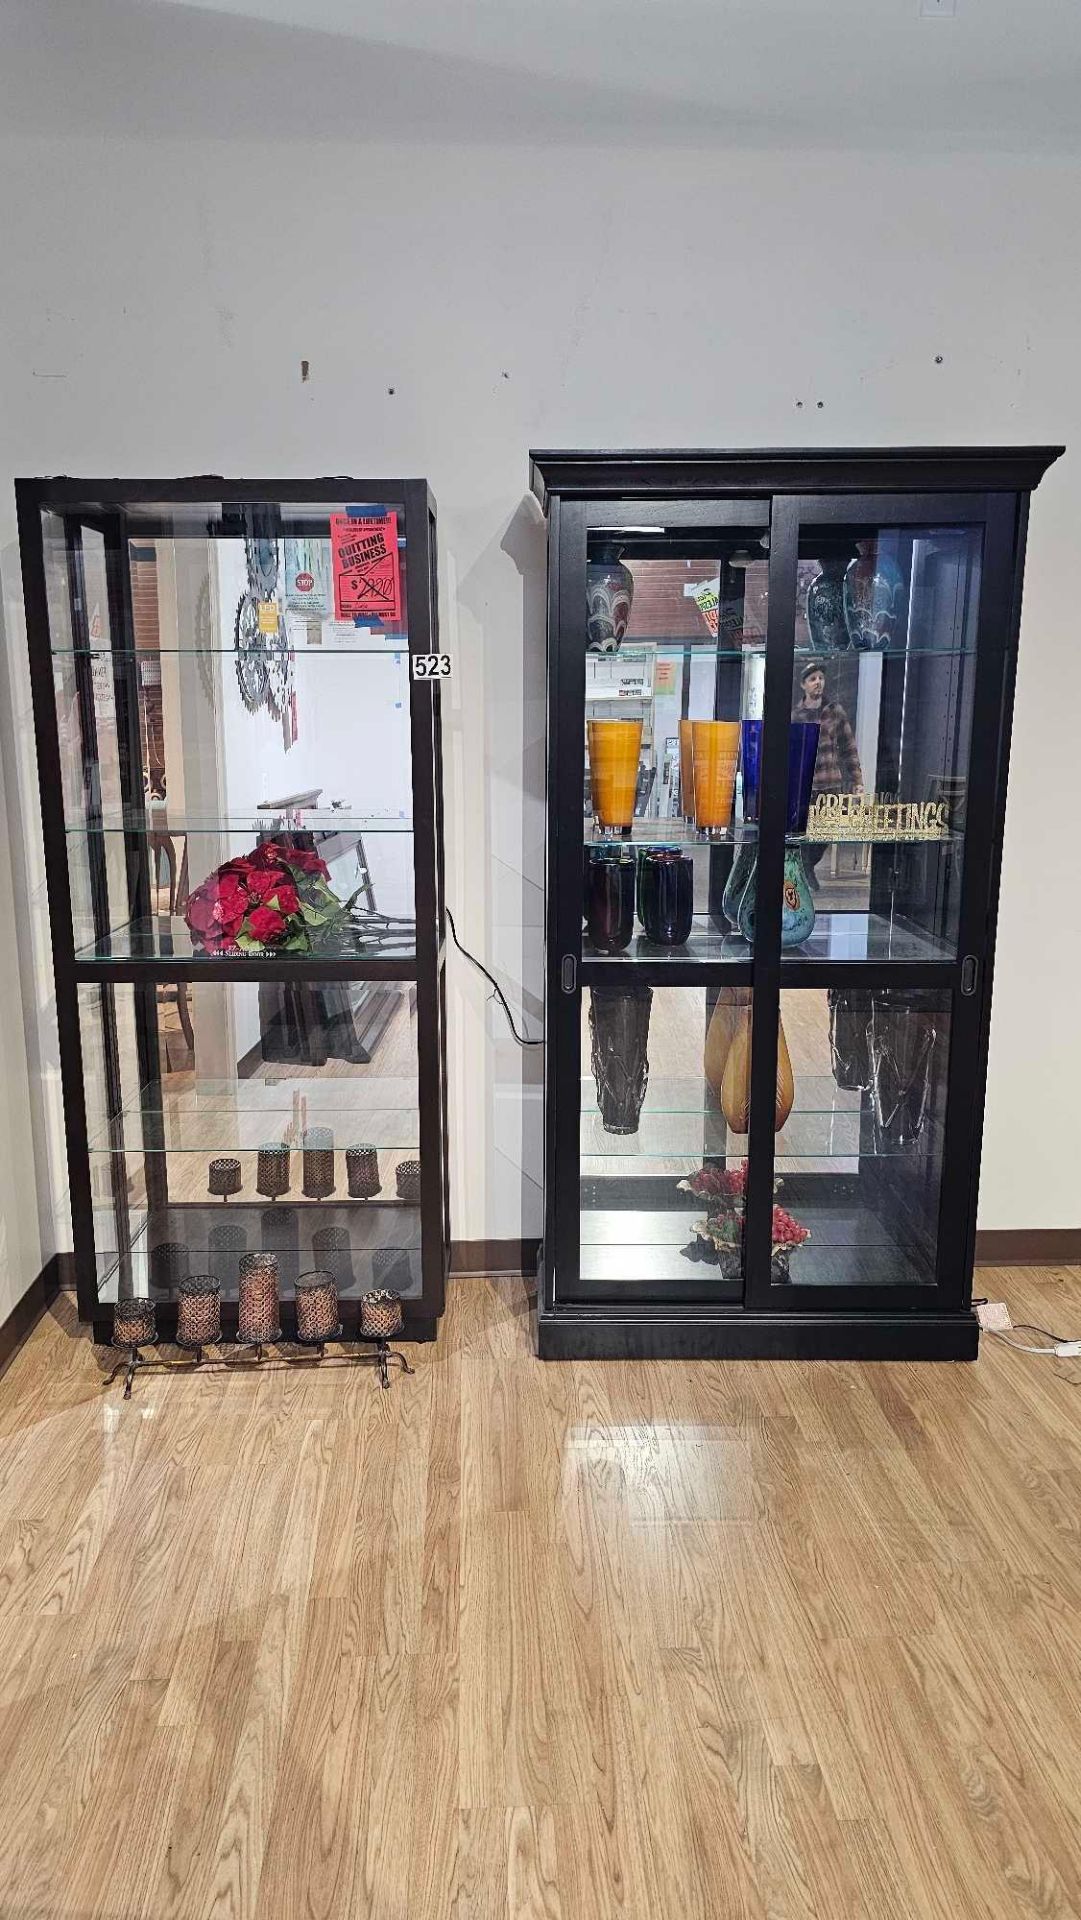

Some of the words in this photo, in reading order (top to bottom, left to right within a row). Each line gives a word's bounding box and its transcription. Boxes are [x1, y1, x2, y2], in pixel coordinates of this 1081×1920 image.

[338, 533, 385, 558] QUITTING
[341, 543, 387, 569] BUSINESS
[297, 579, 313, 587] STOP
[415, 655, 451, 677] 523
